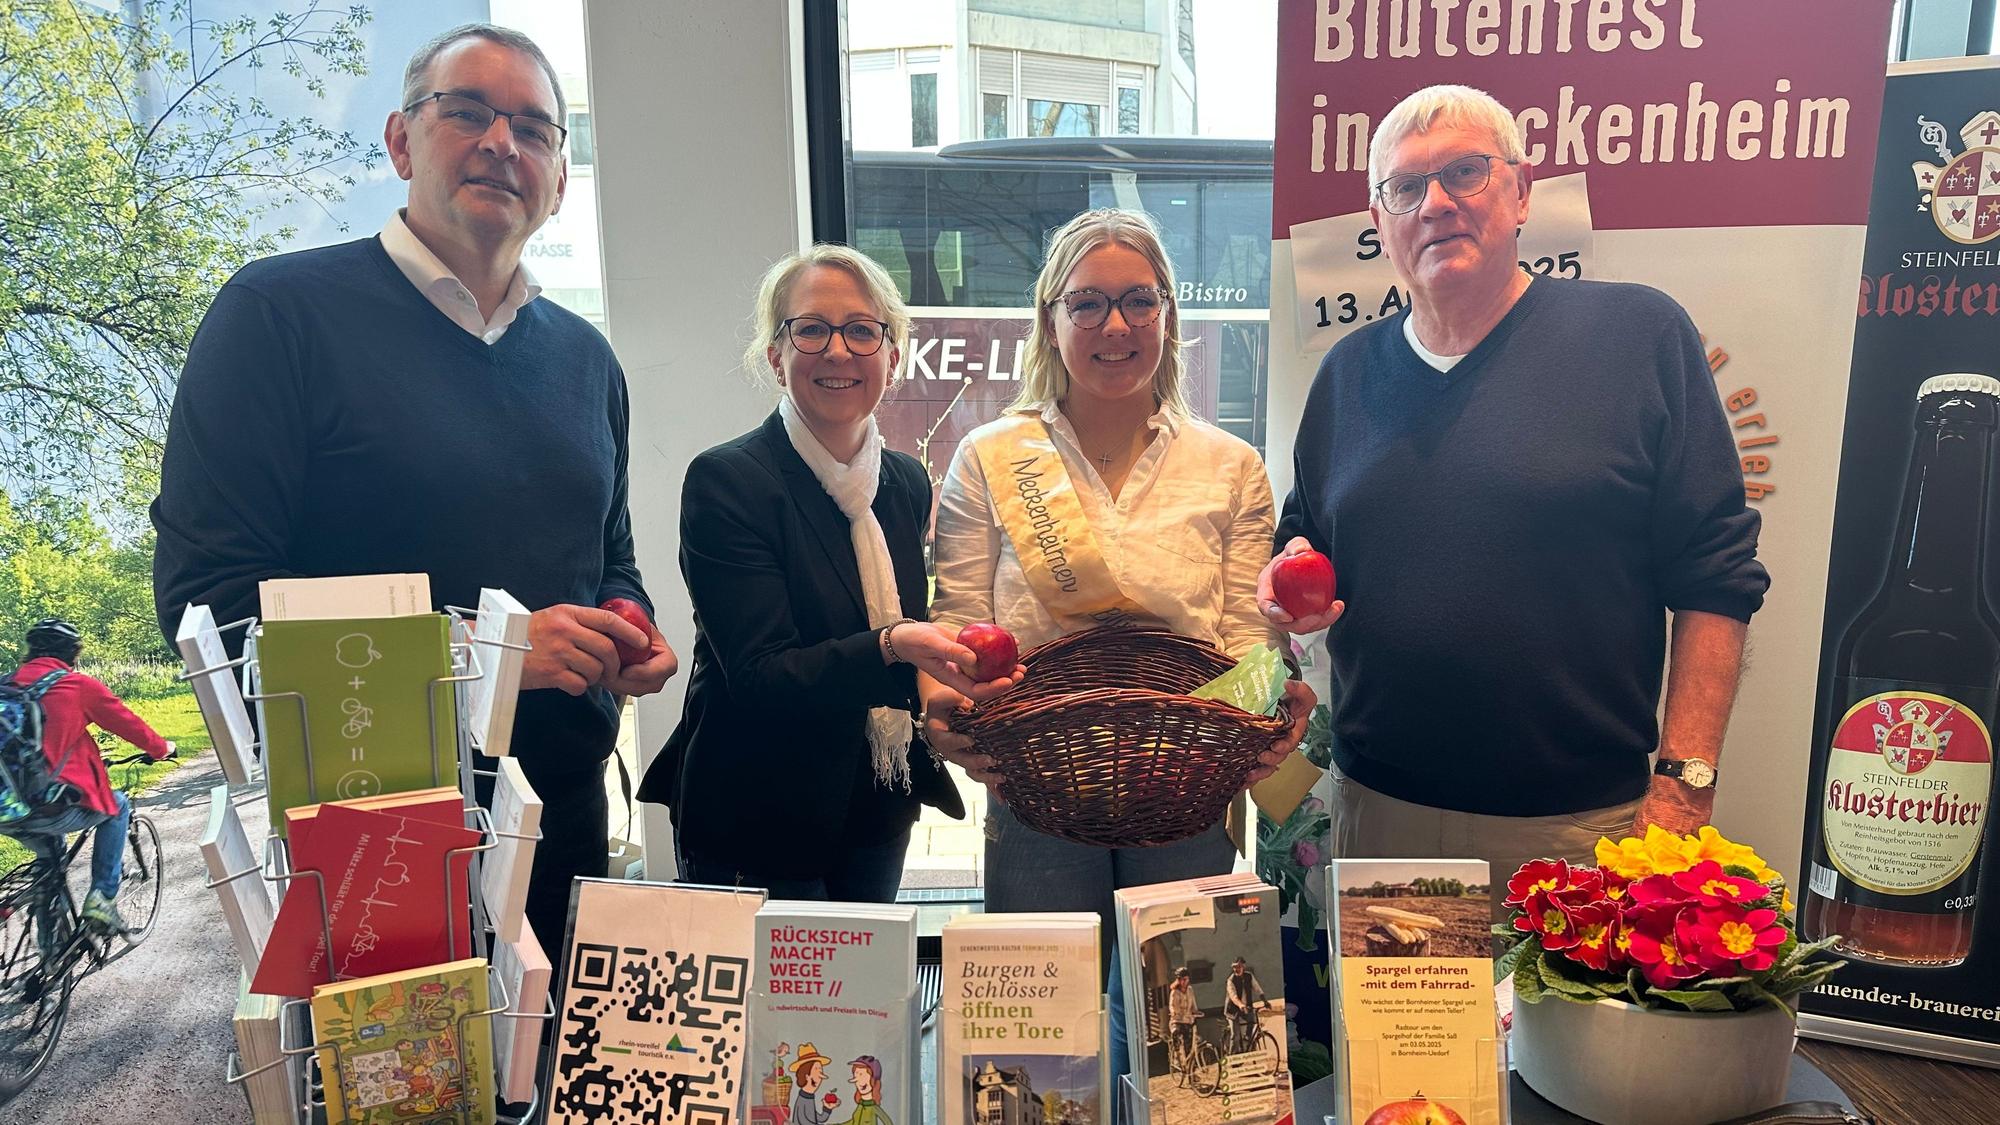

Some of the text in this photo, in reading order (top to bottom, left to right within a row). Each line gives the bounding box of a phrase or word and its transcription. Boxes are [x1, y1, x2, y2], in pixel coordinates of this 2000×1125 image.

[1311, 79, 1850, 173] in ckenheim
[526, 243, 573, 257] RASSE
[1901, 250, 2000, 269] STEINFEL
[1179, 281, 1248, 302] Bistro
[1315, 285, 1411, 328] 13.A
[893, 338, 1025, 380] KE-LI
[1010, 456, 1078, 593] Meckenheimer
[1862, 772, 1949, 791] STEINFELDER
[1828, 779, 1981, 826] Klosterbier
[1854, 823, 1896, 834] Meisterhand
[1898, 829, 1925, 838] gebraut
[1854, 831, 1906, 844] Reinheitsgebot
[770, 925, 874, 946] RÜCKSICHT
[770, 946, 837, 961] MACHT
[769, 963, 822, 978] WEGE
[961, 961, 1058, 982] Burgen &
[1366, 965, 1469, 977] Spargel erfahren
[769, 980, 824, 995] BREIT
[961, 981, 1059, 999] Schlösser
[1361, 980, 1475, 989] -mit dem Fahrrad-
[962, 1001, 1033, 1019] öffnen
[962, 1022, 1064, 1039] ihre Tore
